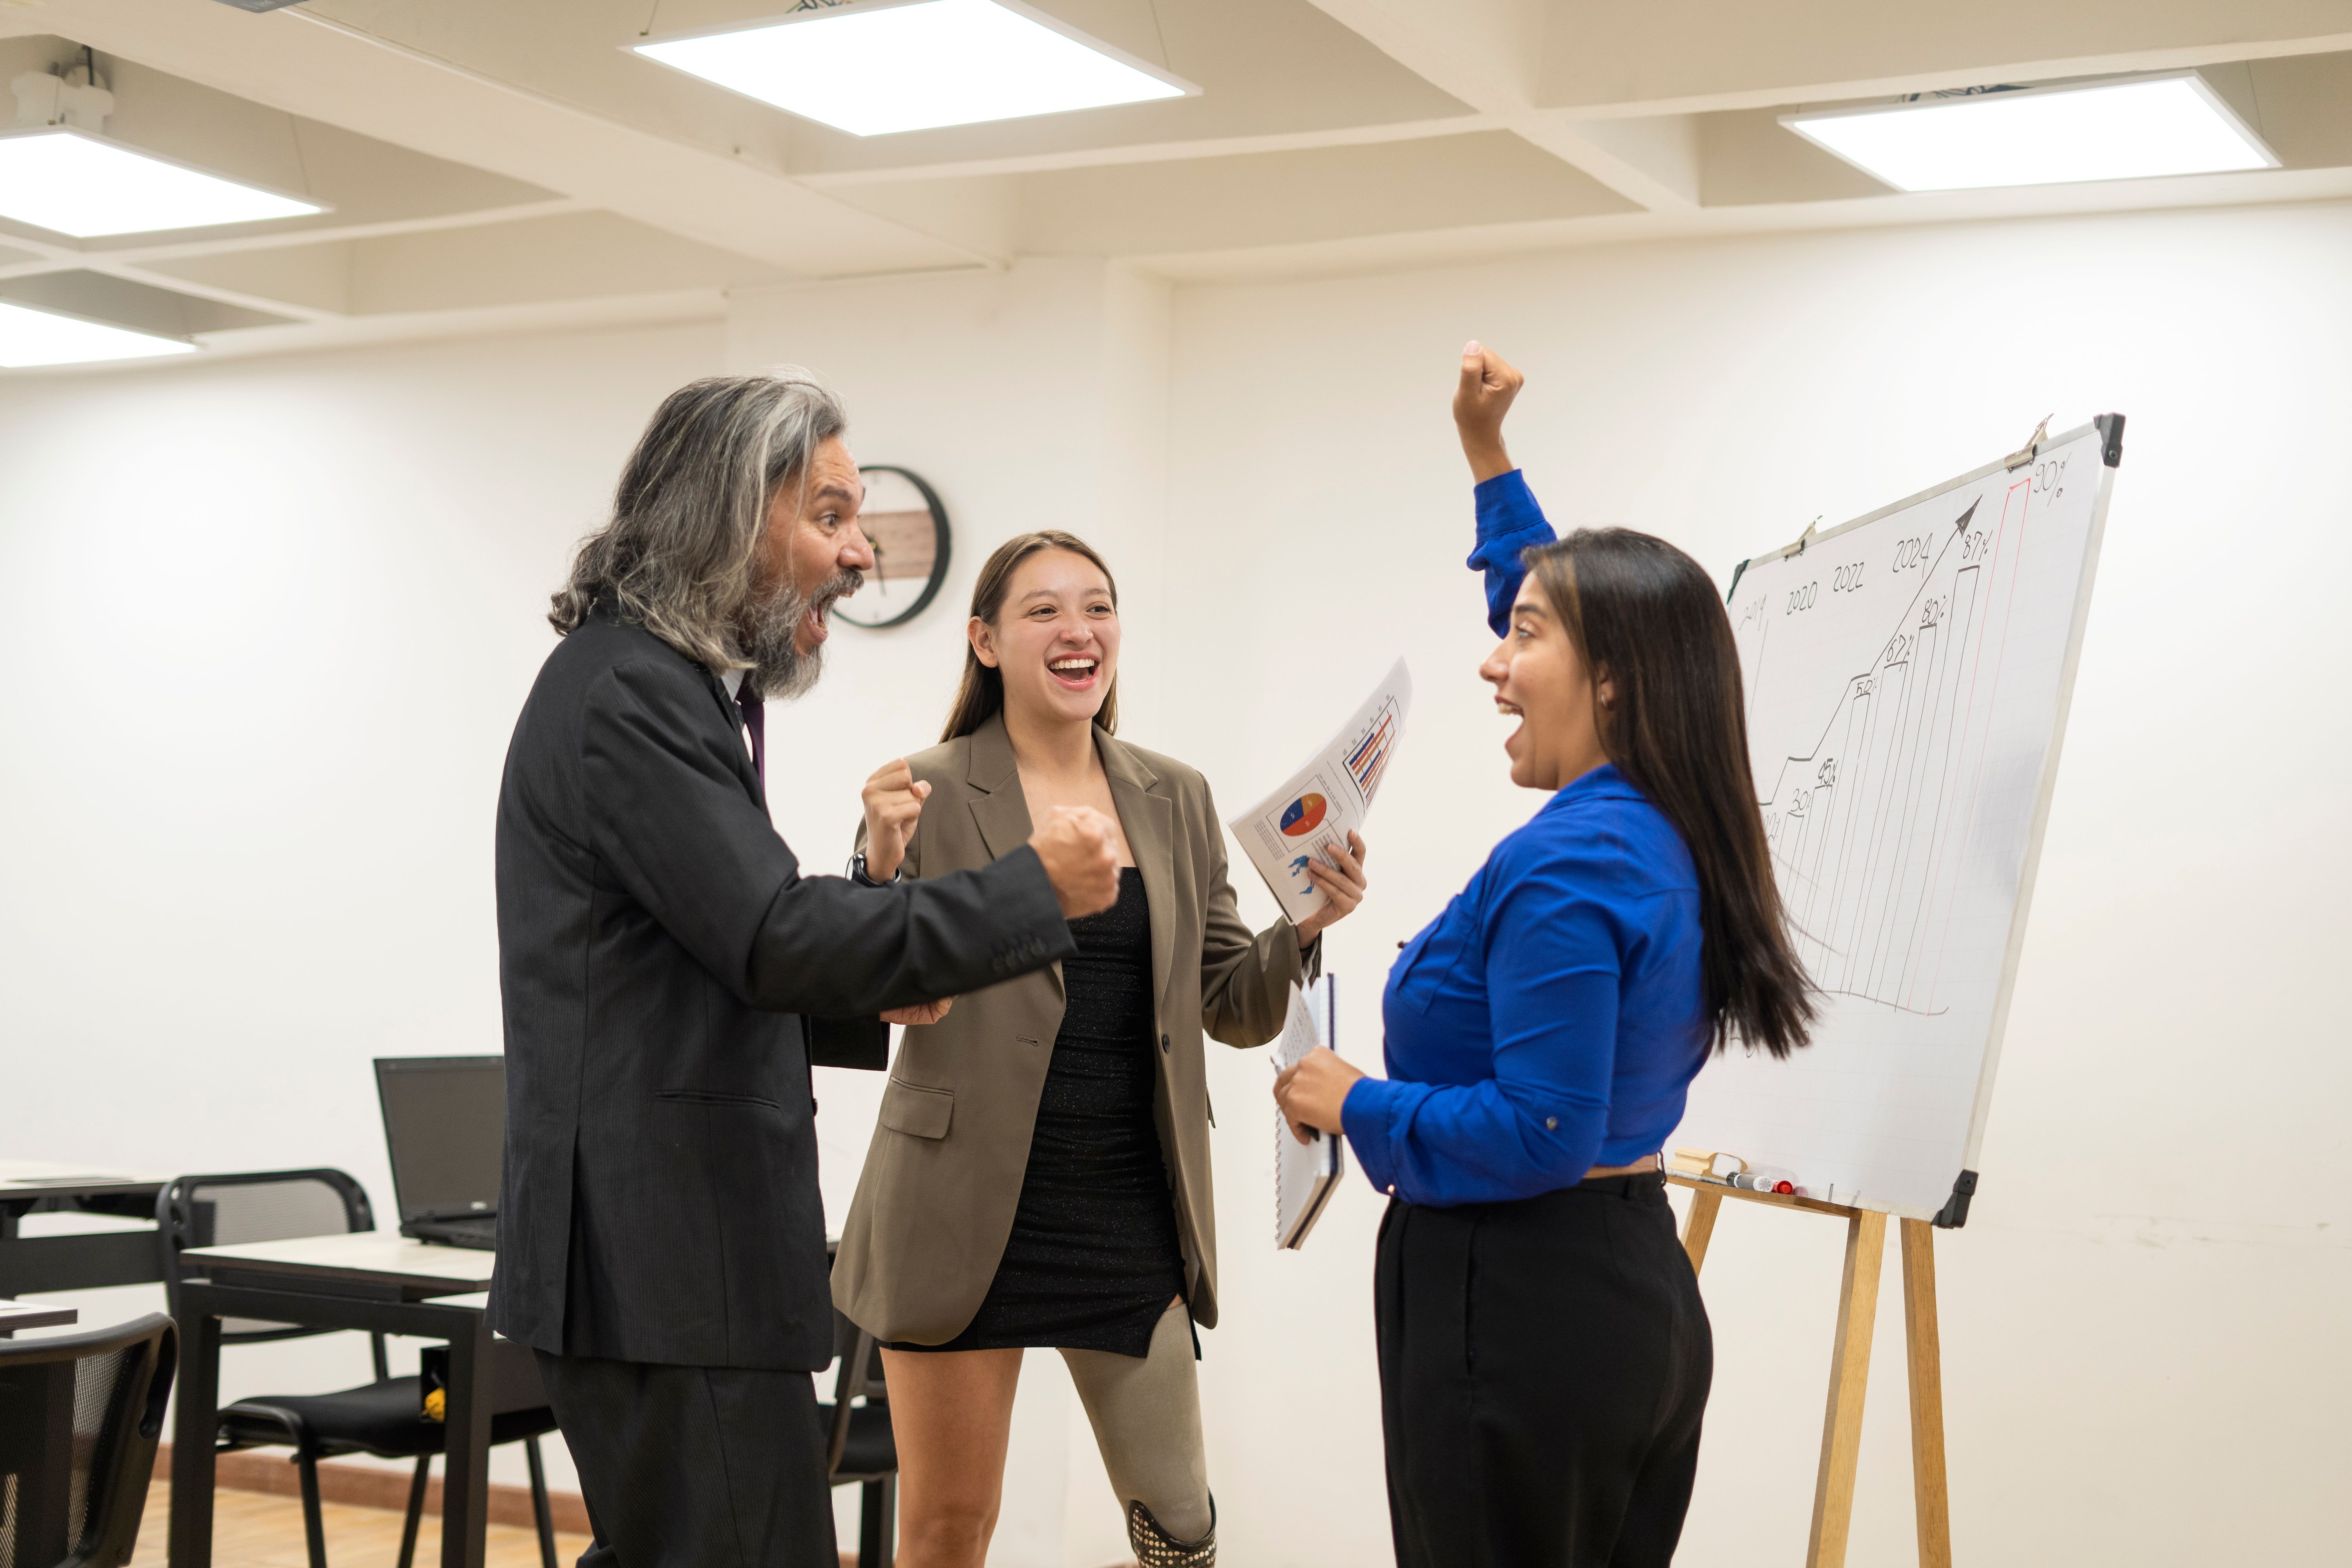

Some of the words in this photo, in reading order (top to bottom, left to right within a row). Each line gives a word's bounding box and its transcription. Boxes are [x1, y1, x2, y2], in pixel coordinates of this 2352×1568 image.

[2033, 451, 2072, 507] 90%
[1963, 529, 1993, 562] 87%
[1786, 581, 1817, 615] 2020
[1833, 561, 1864, 592] 2022
[1892, 532, 1933, 579] 2024
[1922, 594, 1948, 628] 80%
[1887, 633, 1915, 672] 67%
[1856, 676, 1879, 696] 50%
[1818, 757, 1838, 790] 45%
[1790, 788, 1812, 812] 30%
